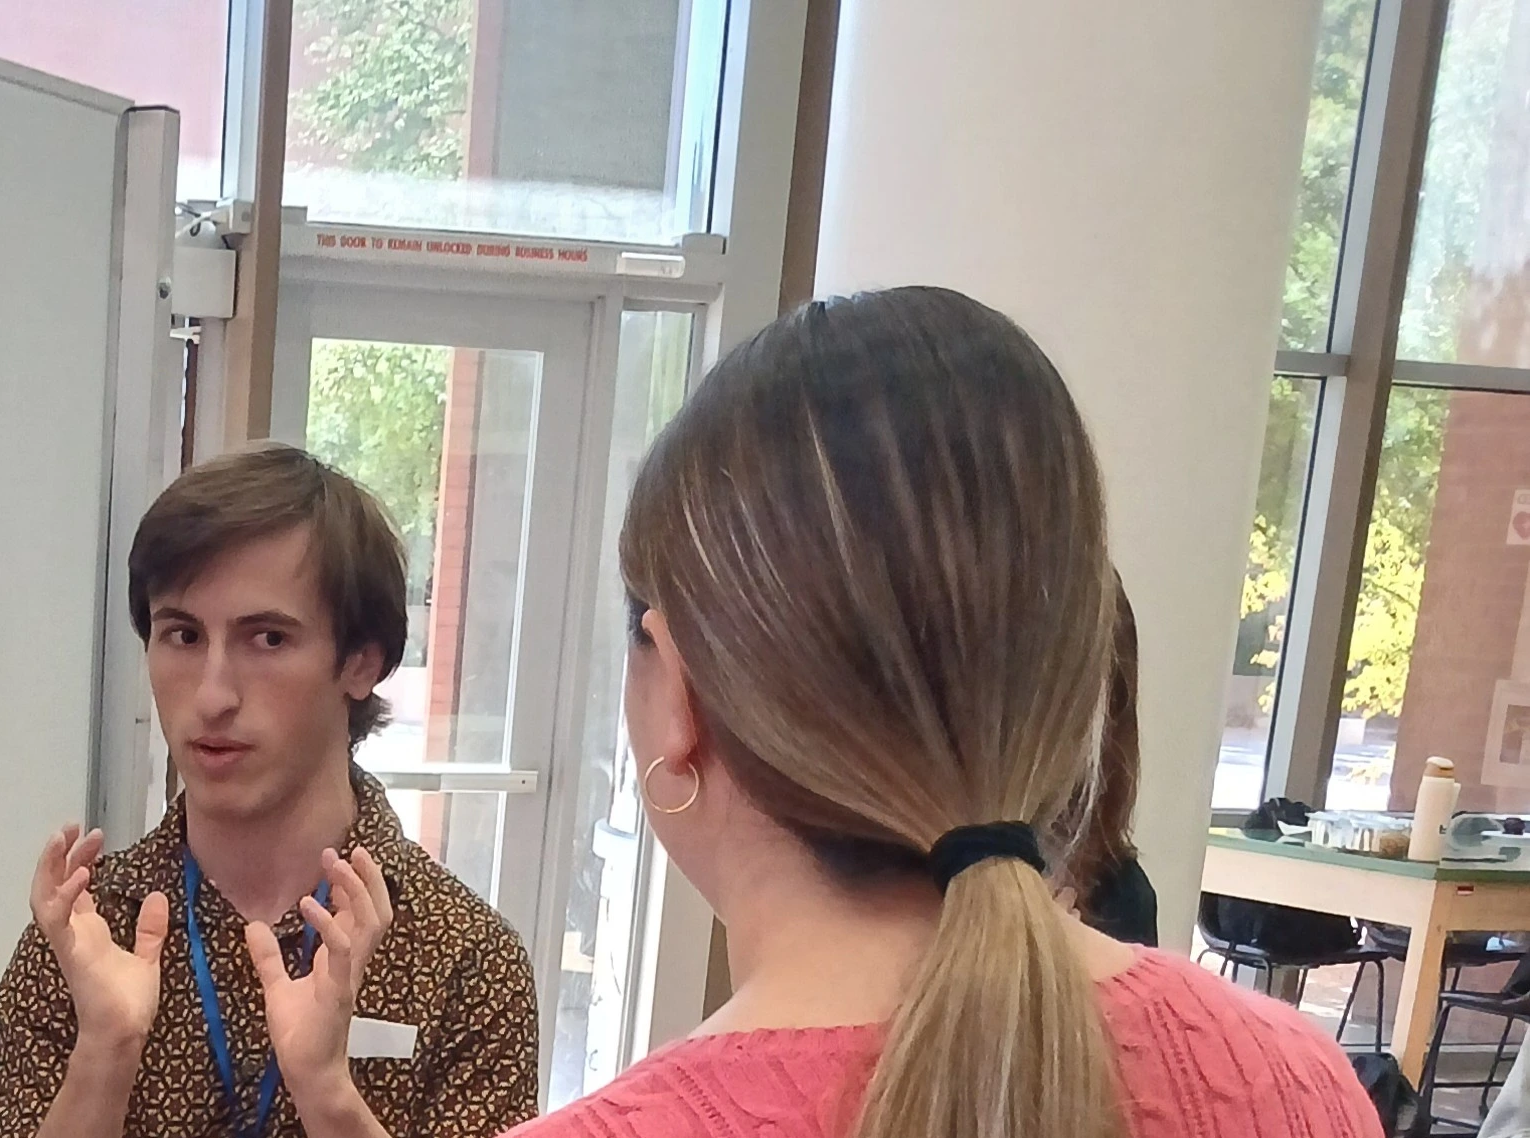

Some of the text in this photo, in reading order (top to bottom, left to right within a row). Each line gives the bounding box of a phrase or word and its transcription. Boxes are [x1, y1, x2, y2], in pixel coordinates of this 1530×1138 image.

[317, 234, 588, 262] THIS DOOR TO REMAIN UNLOCKED DURING BUSINESS HOURS
